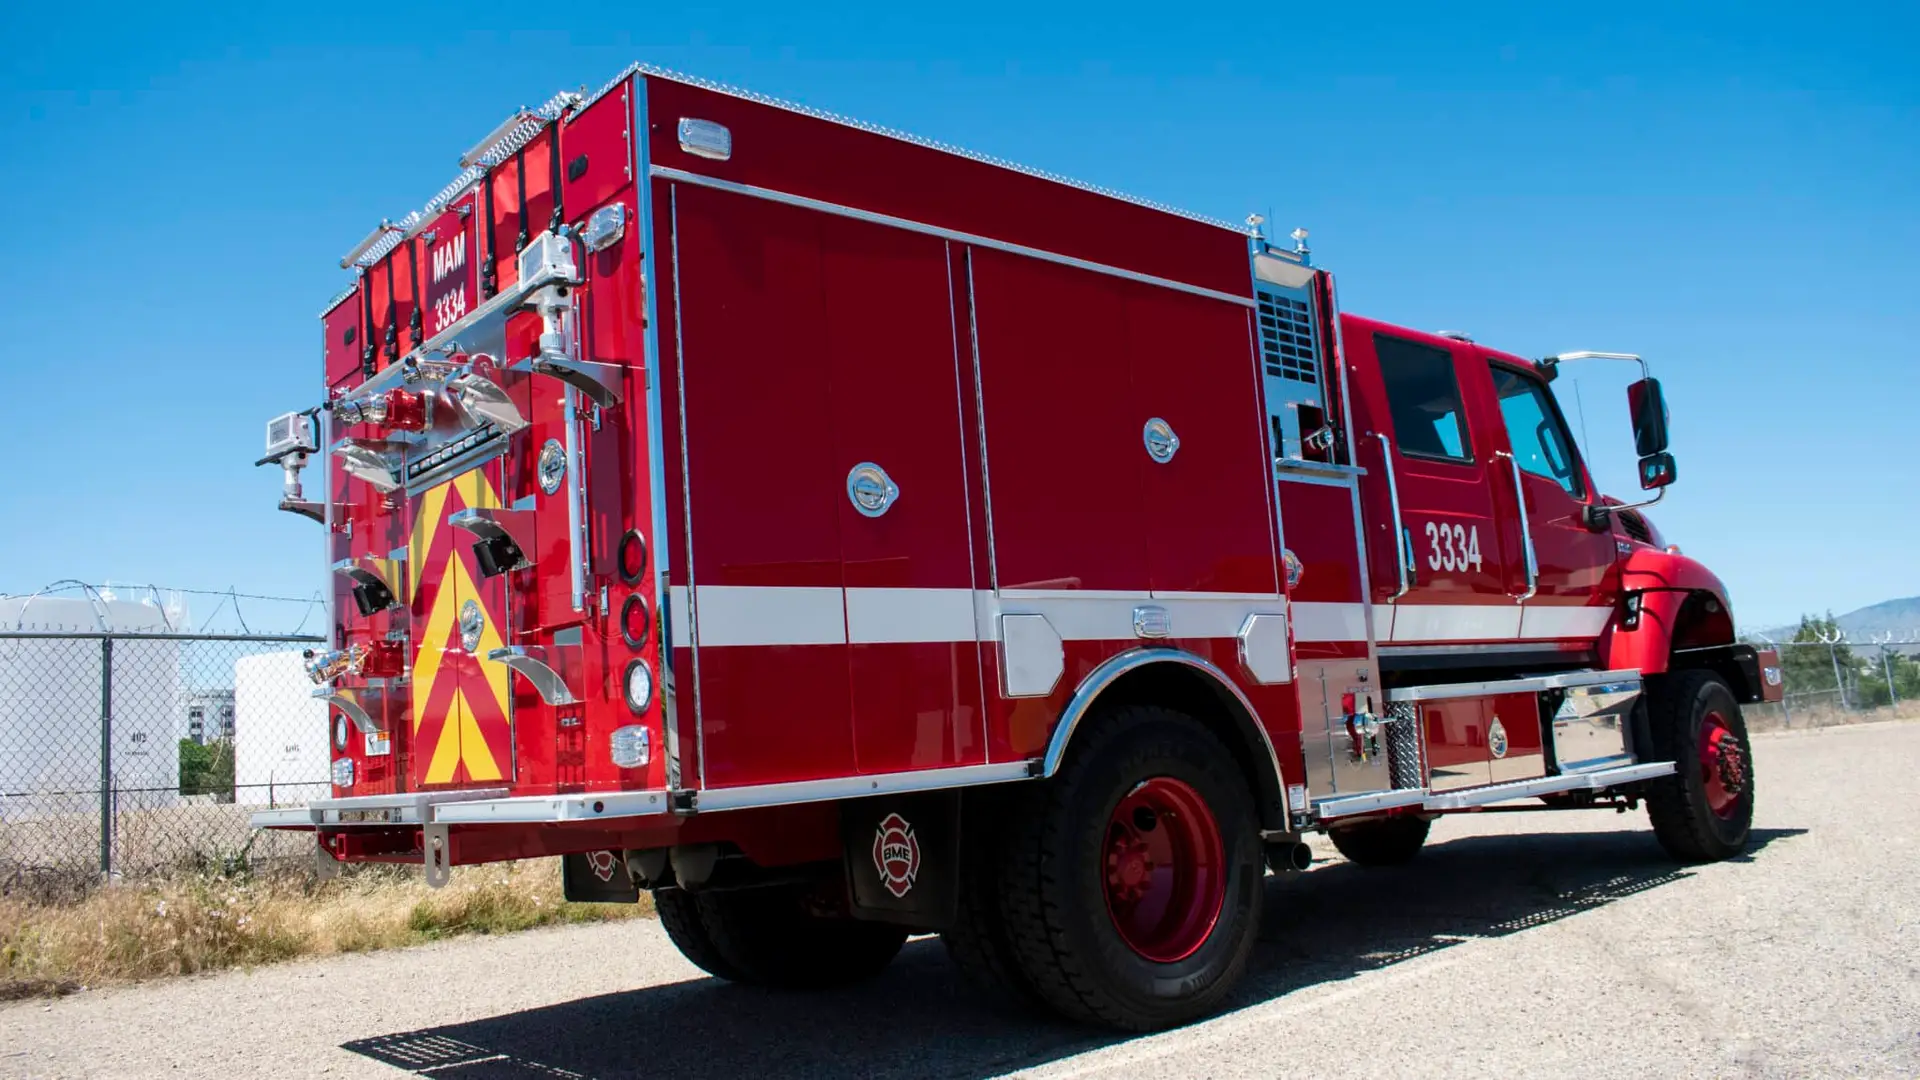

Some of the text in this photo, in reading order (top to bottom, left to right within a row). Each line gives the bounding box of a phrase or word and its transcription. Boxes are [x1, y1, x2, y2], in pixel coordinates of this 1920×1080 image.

[433, 231, 465, 285] MAM
[435, 281, 466, 332] 3334
[1425, 521, 1482, 573] 3334
[884, 845, 910, 861] BME
